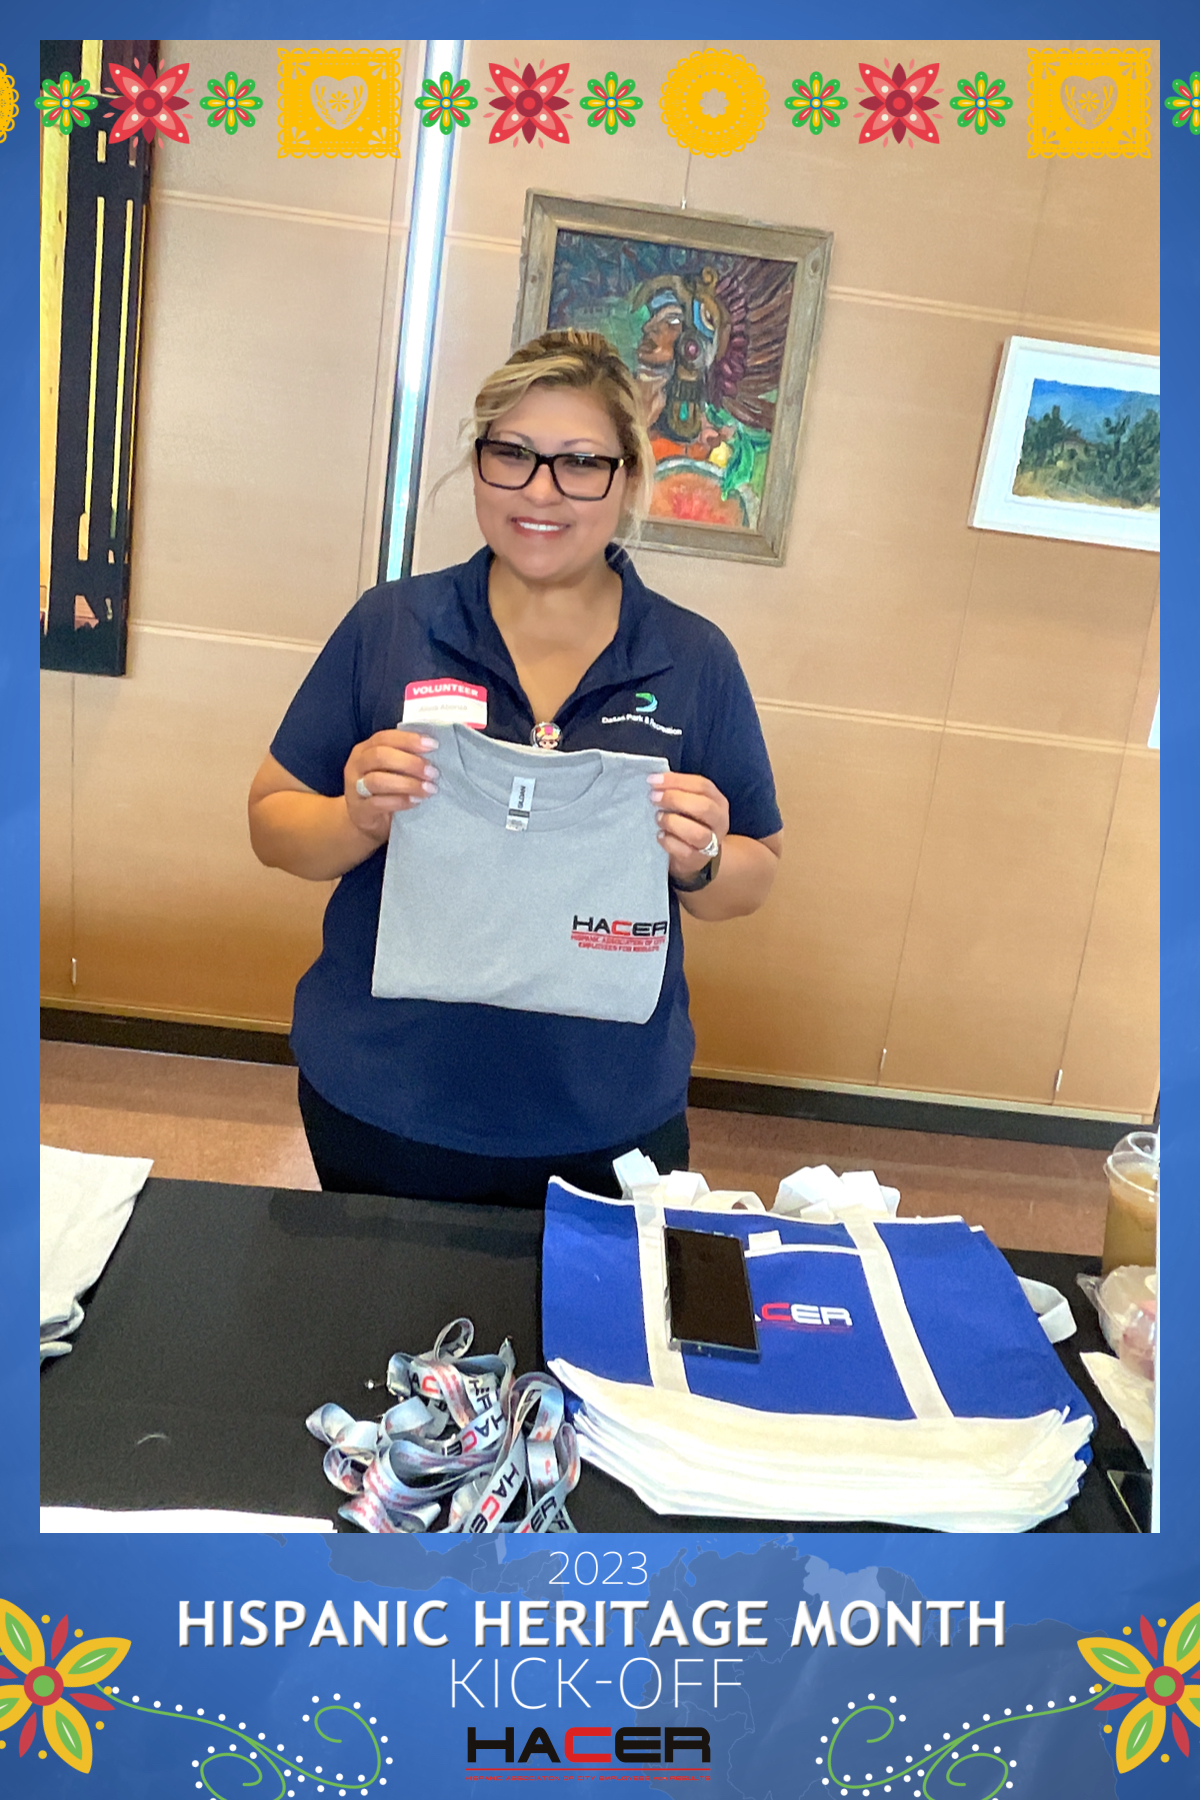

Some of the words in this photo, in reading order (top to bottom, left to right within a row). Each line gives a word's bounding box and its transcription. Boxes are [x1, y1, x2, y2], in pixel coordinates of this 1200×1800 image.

[412, 683, 478, 697] VOLUNTEER
[572, 915, 668, 937] HACER
[755, 1302, 853, 1326] CER
[442, 1413, 504, 1457] HACE
